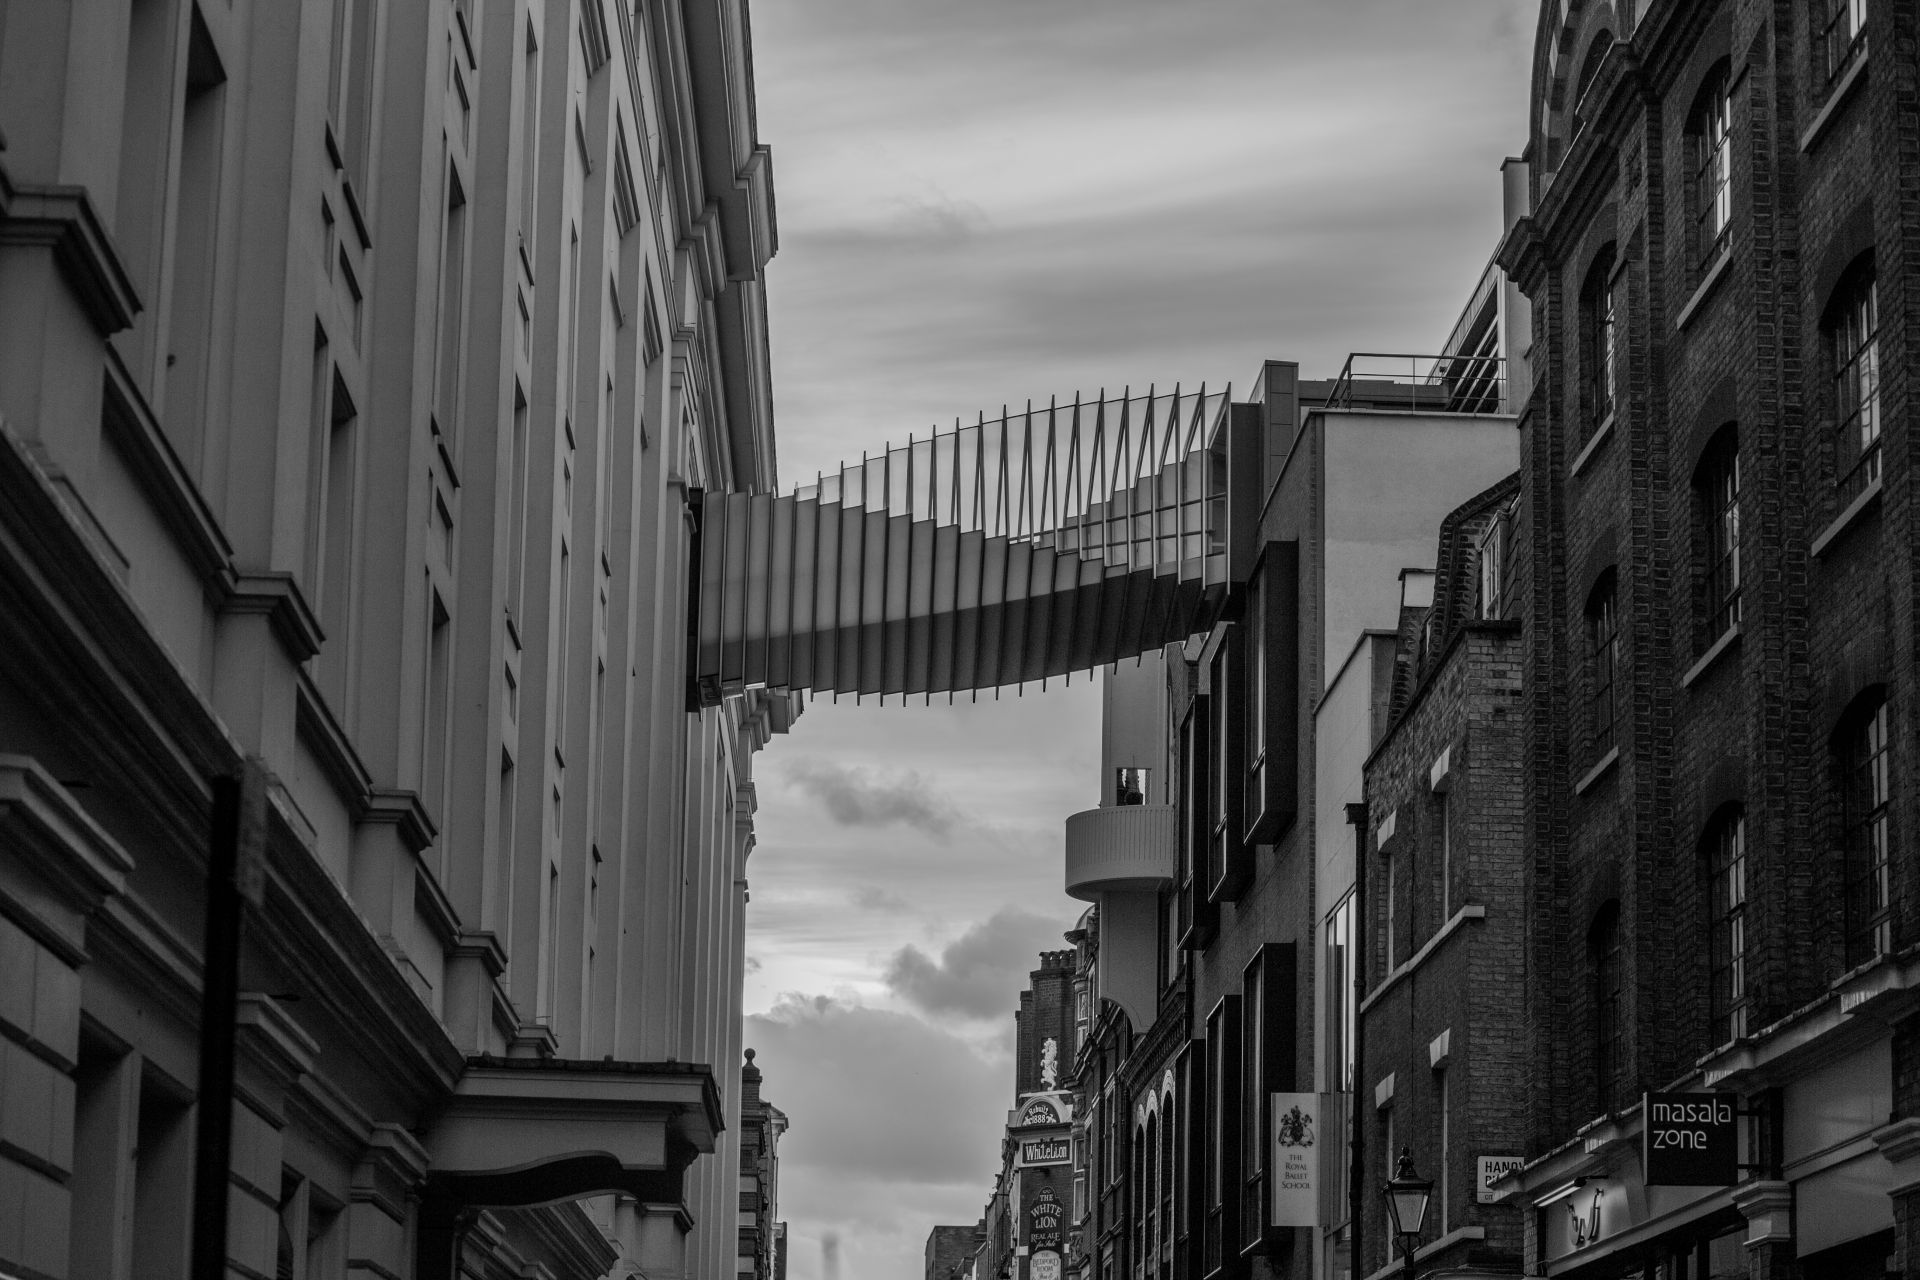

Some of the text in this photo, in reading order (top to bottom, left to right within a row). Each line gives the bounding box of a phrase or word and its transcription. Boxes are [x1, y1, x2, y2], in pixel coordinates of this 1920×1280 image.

[1653, 1098, 1731, 1126] masala
[1653, 1129, 1707, 1149] zone
[1285, 1162, 1308, 1170] ROYAL
[1285, 1171, 1308, 1180] BALLET
[1281, 1181, 1311, 1189] SCHOOL
[1040, 1194, 1054, 1202] THE
[1030, 1203, 1062, 1217] WHITE
[1035, 1216, 1057, 1228] LION
[1047, 1232, 1061, 1241] ALE
